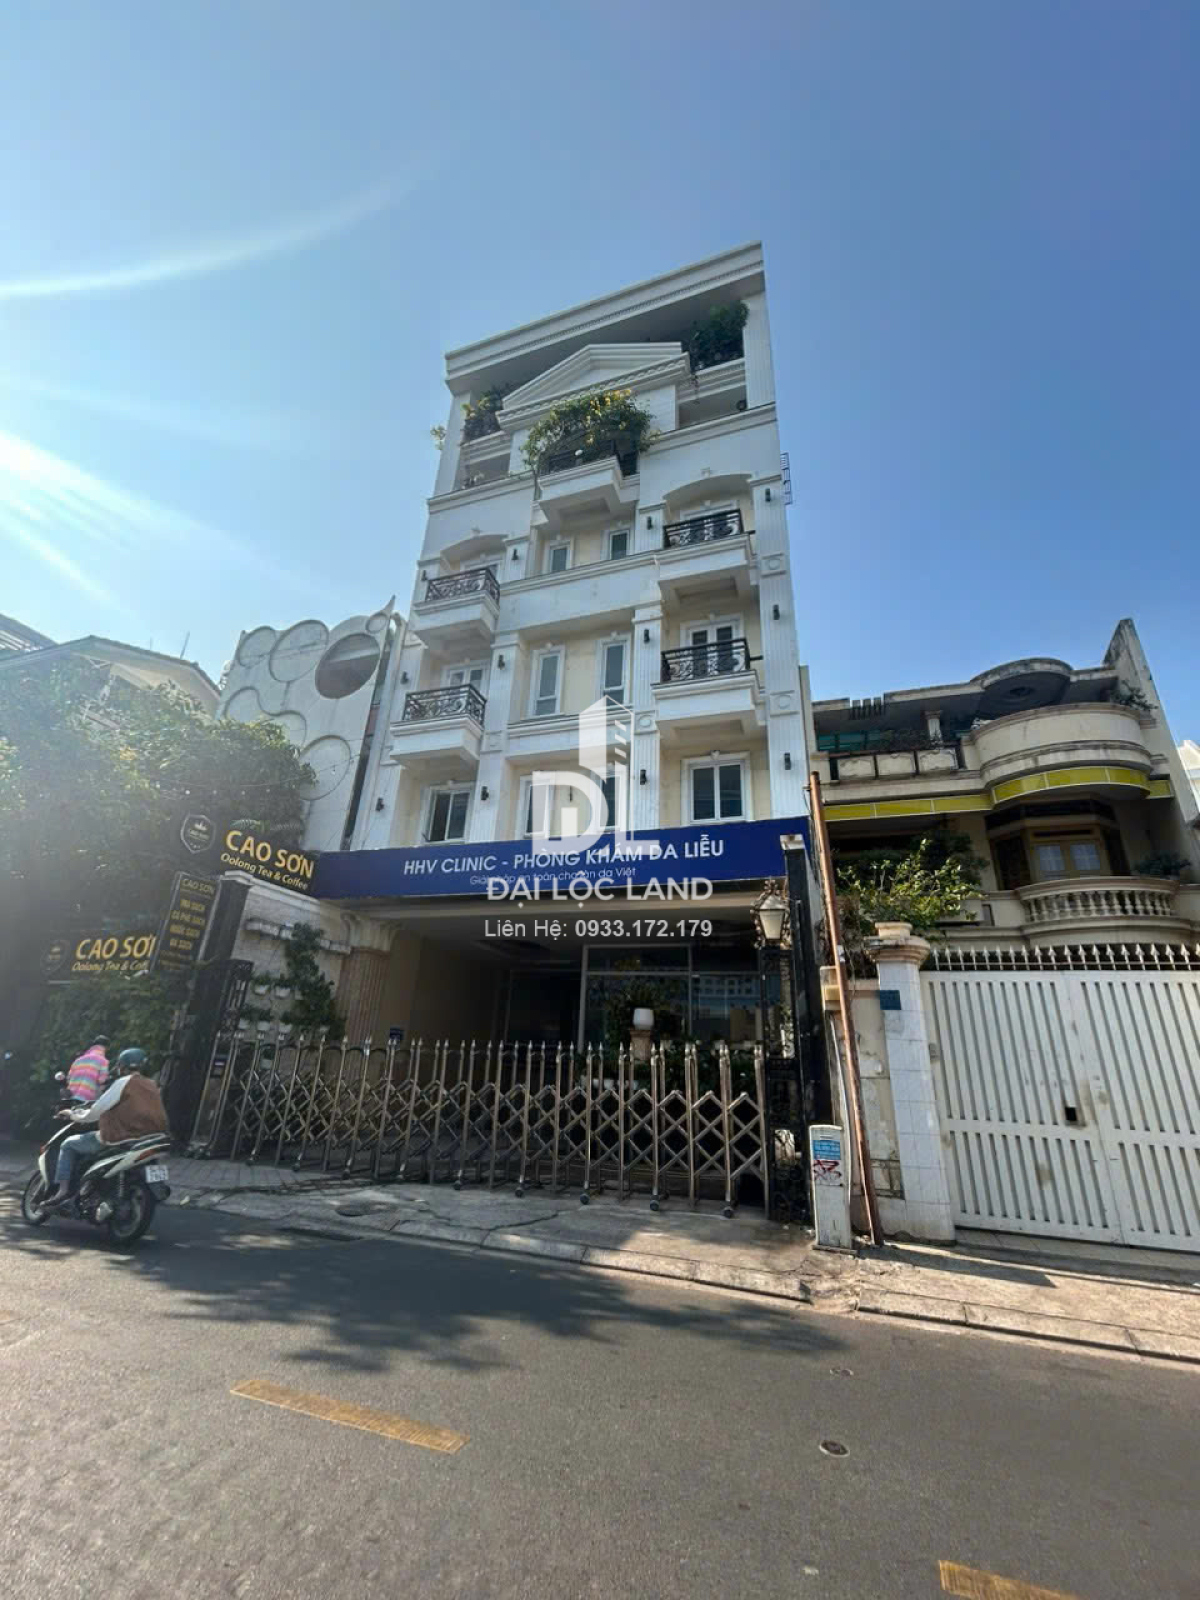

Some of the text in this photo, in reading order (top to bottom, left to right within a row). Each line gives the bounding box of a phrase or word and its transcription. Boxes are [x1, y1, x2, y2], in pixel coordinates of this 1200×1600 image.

[221, 852, 309, 890] Oolong Tea & Coffee
[226, 830, 272, 861] CAO
[275, 849, 315, 878] SƠN
[403, 859, 438, 875] HHV
[441, 855, 497, 873] CLINIC
[514, 848, 580, 869] PHÒNG
[586, 841, 642, 865] KHÁM
[649, 843, 679, 860] DA
[684, 833, 724, 858] LIỄU
[577, 868, 596, 880] àn
[75, 937, 118, 960] CAO
